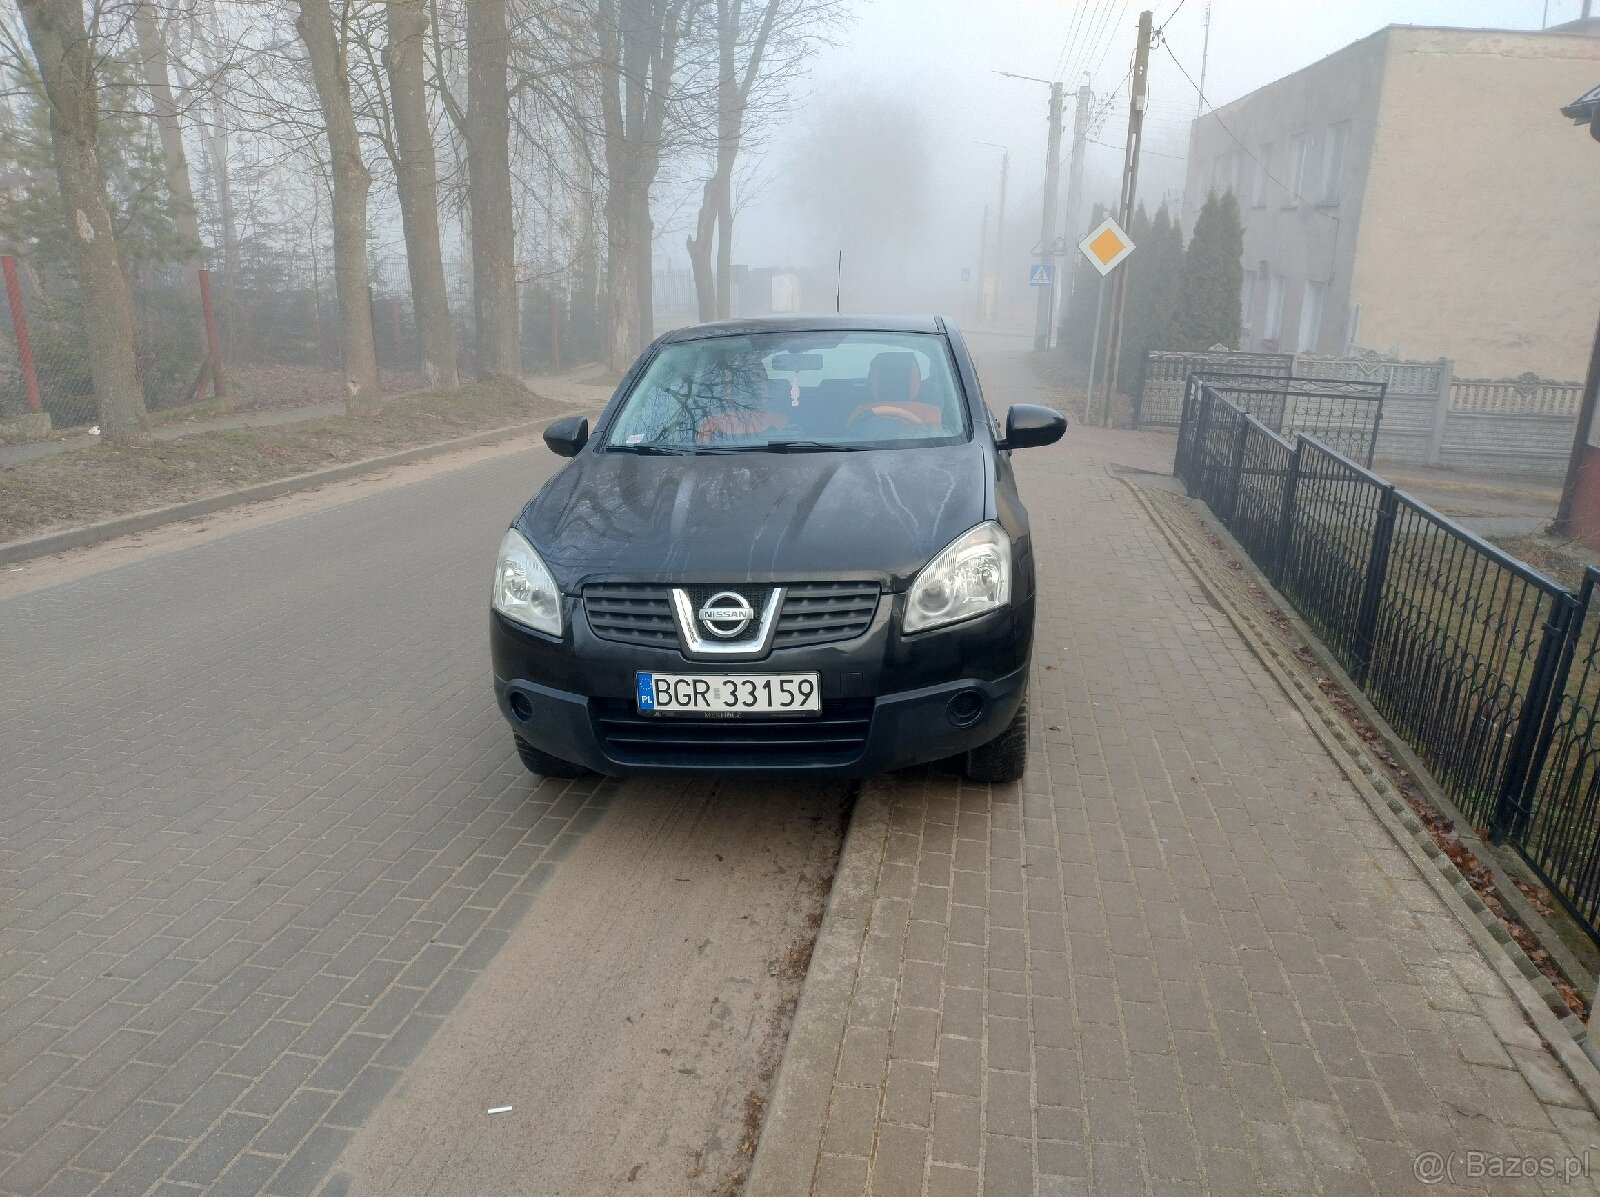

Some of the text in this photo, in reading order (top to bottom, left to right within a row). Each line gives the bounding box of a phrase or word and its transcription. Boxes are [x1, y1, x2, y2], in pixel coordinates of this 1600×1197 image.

[641, 695, 653, 704] PL
[654, 678, 814, 707] BGR 33159
